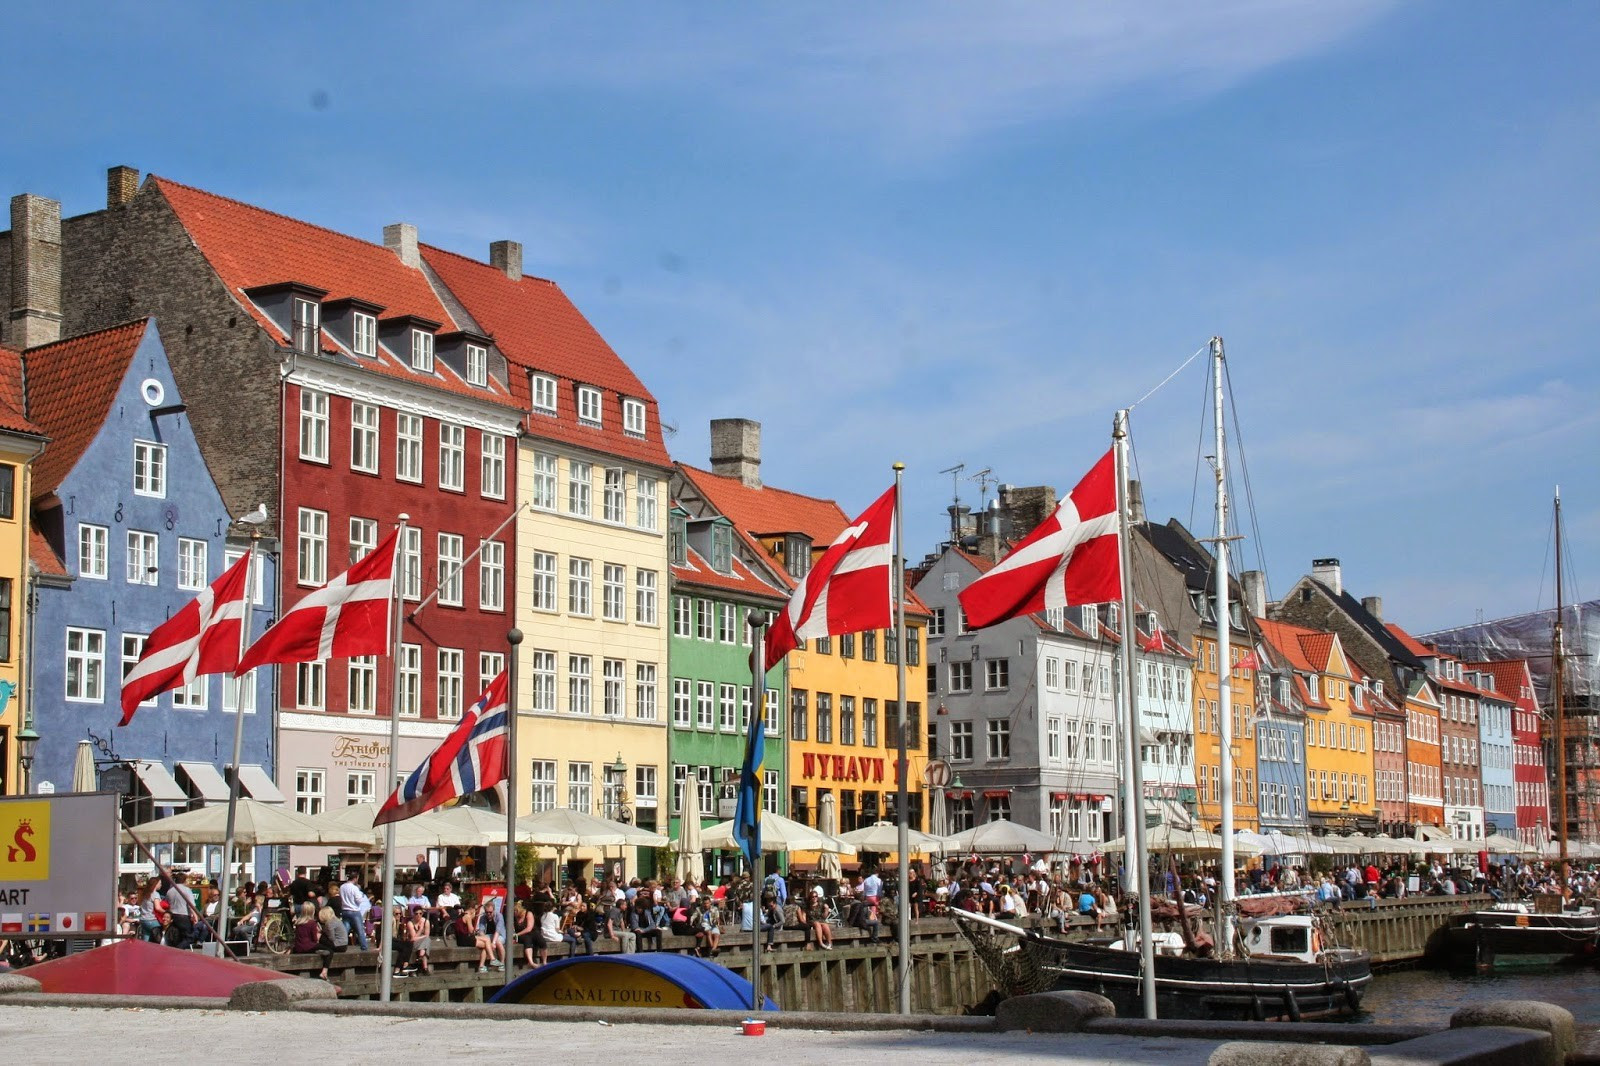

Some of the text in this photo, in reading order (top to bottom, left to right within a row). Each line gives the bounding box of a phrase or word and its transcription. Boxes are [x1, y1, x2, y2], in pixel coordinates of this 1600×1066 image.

[802, 752, 885, 783] NYHAVN
[924, 763, 945, 785] 17
[553, 987, 662, 1003] CANAL TOURS
